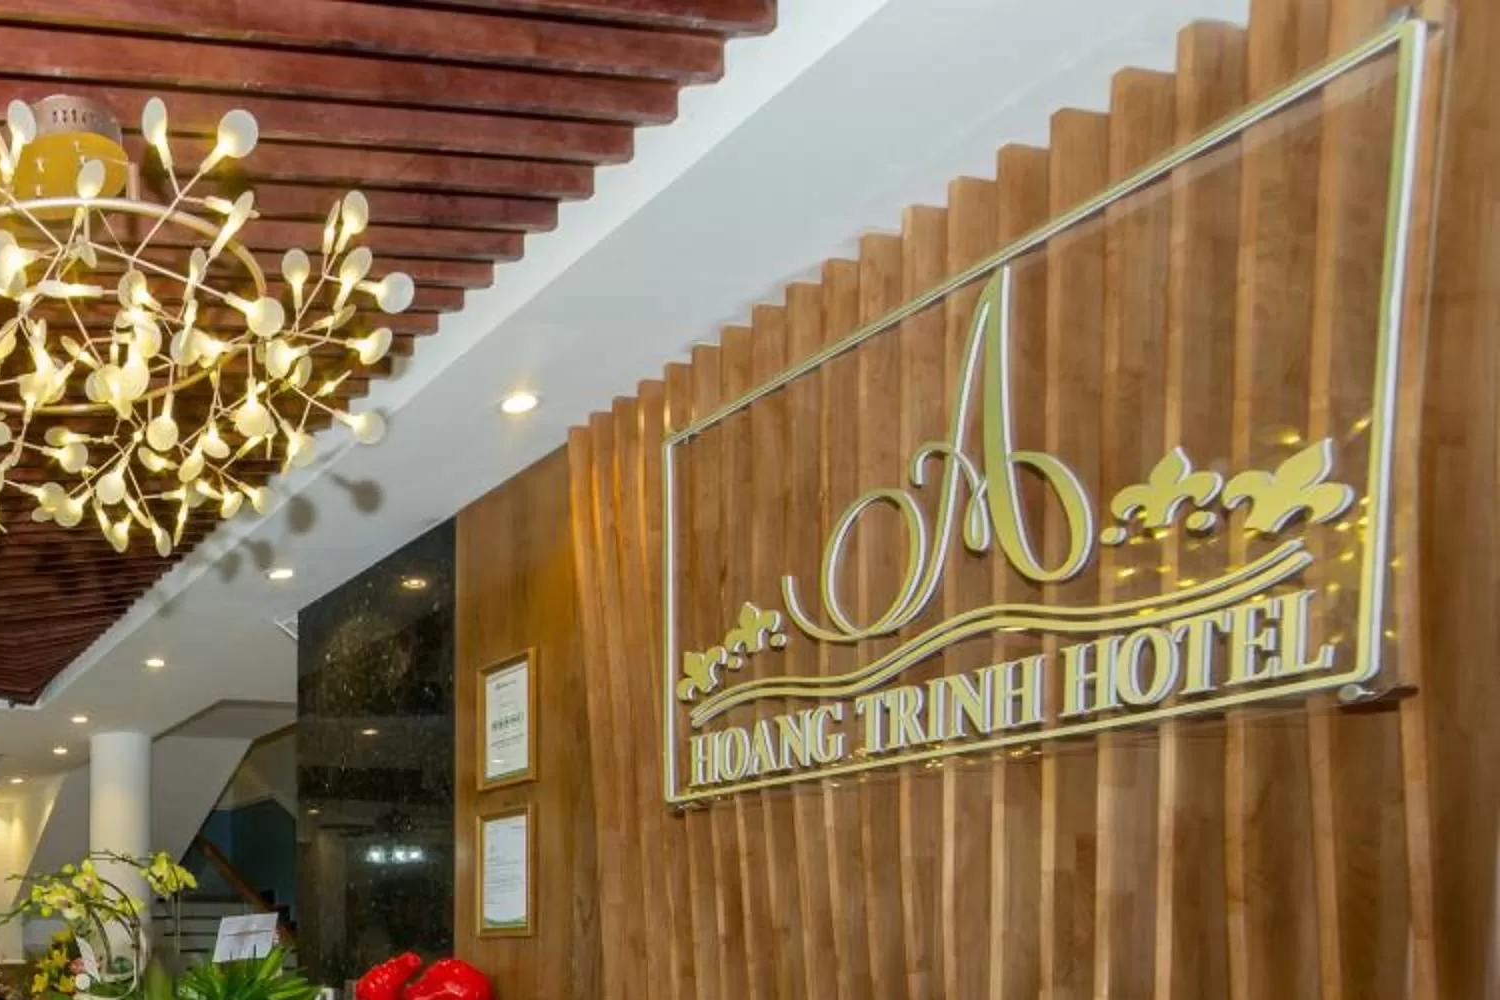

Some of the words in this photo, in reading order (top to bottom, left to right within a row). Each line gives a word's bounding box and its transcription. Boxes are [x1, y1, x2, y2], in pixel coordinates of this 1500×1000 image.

[688, 701, 845, 787] HOANG
[856, 653, 1046, 755] TRINH
[1060, 589, 1336, 720] HOTEL
